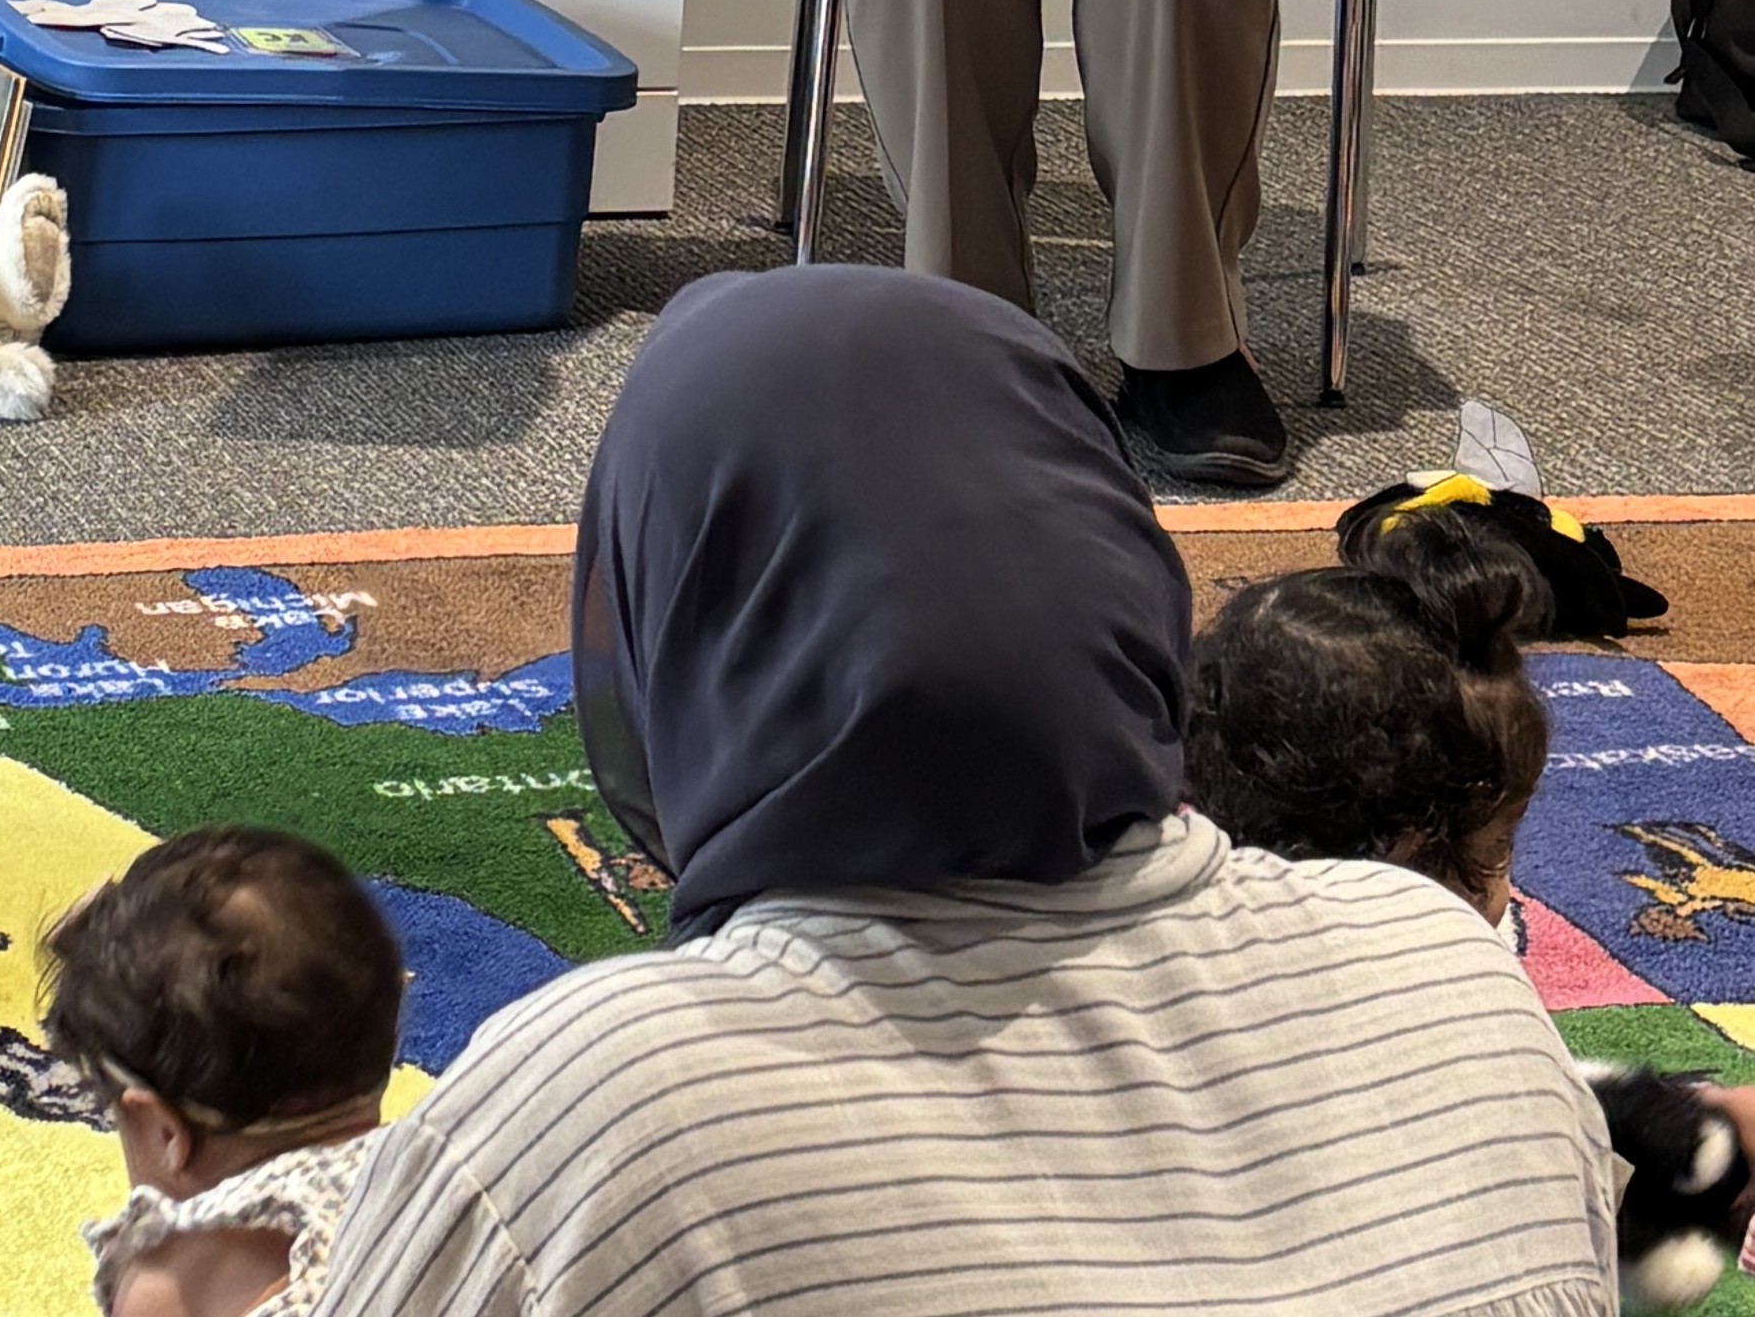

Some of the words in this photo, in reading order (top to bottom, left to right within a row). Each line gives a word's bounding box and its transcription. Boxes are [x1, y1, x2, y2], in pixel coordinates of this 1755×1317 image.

[133, 591, 378, 618] Michigan
[215, 604, 348, 632] Lake
[4, 659, 170, 683] Huron
[29, 676, 168, 700] Lake
[317, 677, 553, 706] Superior
[396, 696, 534, 721] Lake
